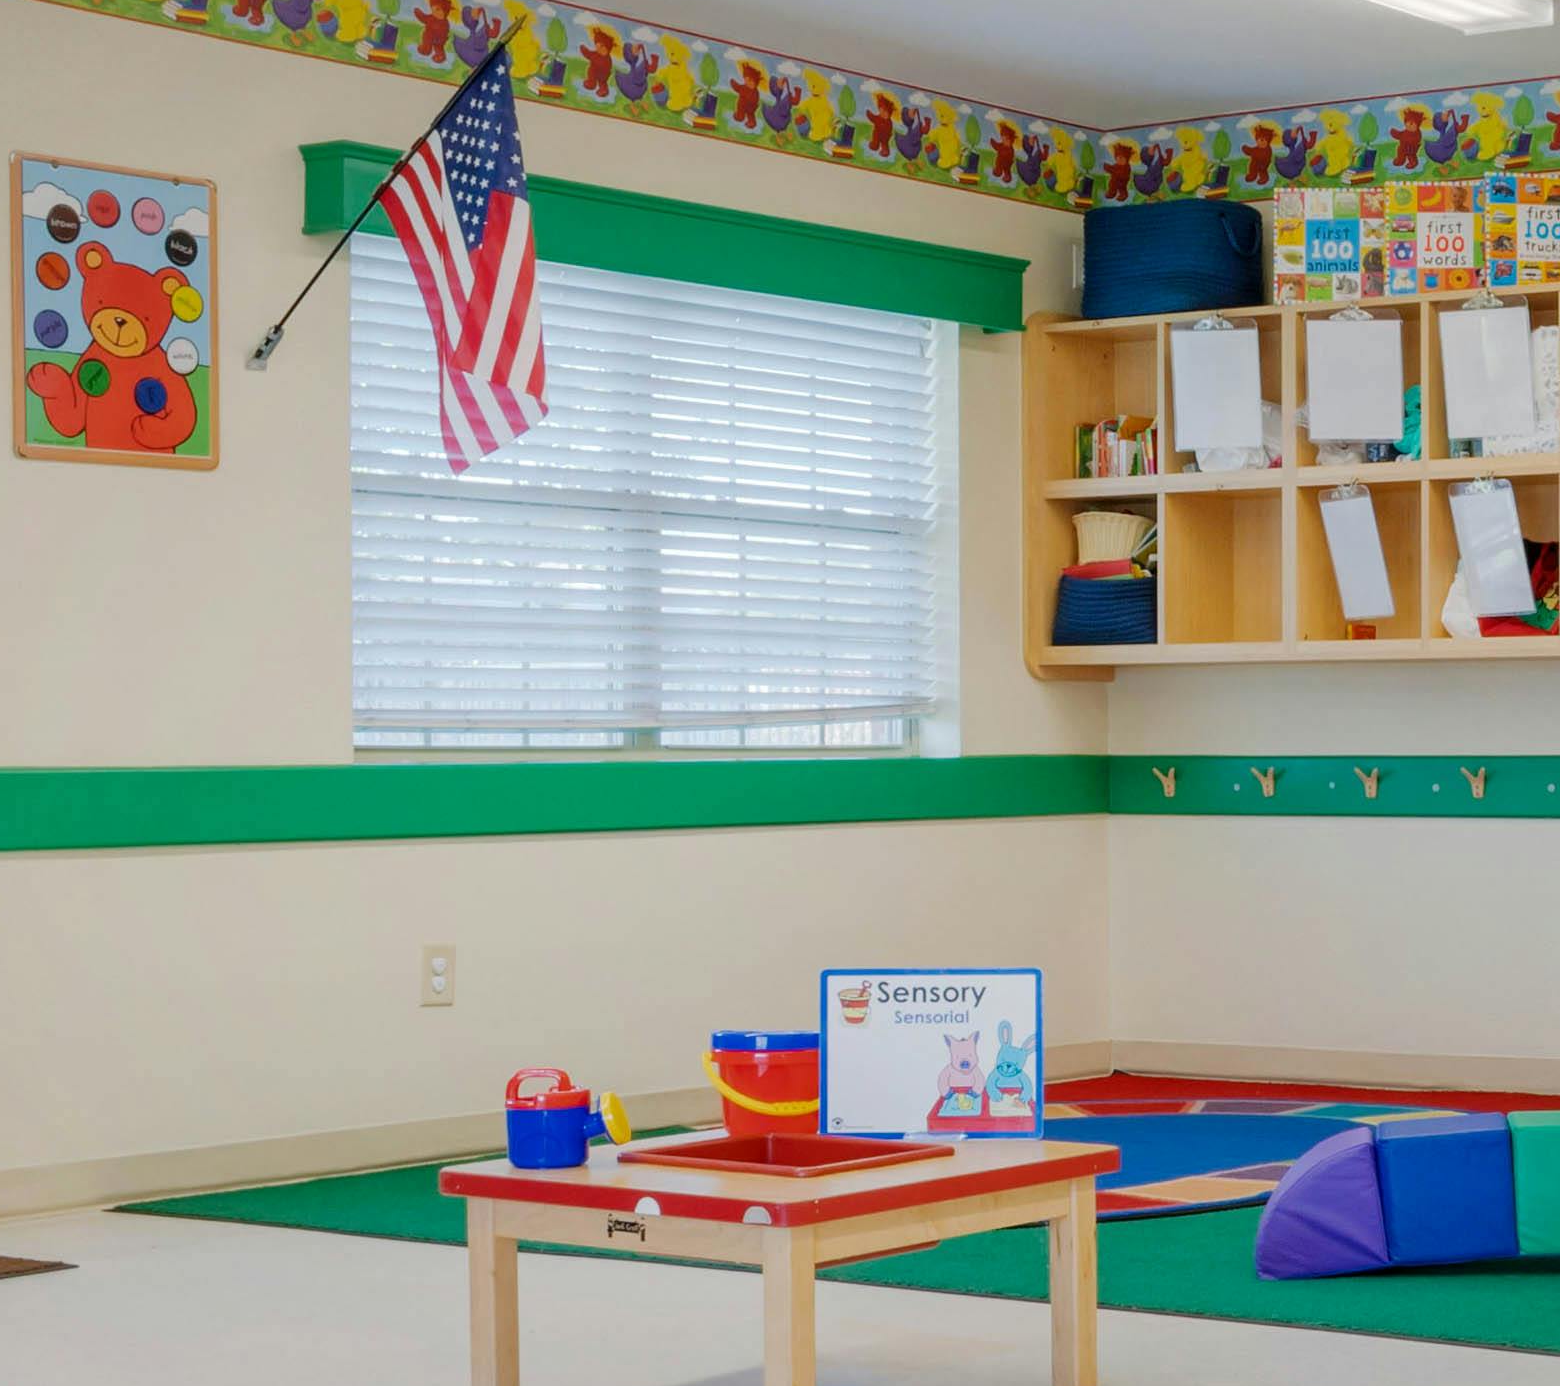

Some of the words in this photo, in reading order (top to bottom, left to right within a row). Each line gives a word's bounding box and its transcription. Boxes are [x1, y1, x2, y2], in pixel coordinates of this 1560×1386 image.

[1315, 226, 1351, 241] first
[1427, 221, 1462, 234] first
[1311, 239, 1354, 260] 100
[1424, 234, 1466, 253] 100
[1307, 258, 1360, 273] animals
[1423, 253, 1468, 266] words
[876, 981, 987, 1008] Sensory
[894, 1010, 969, 1025] Sensorial
